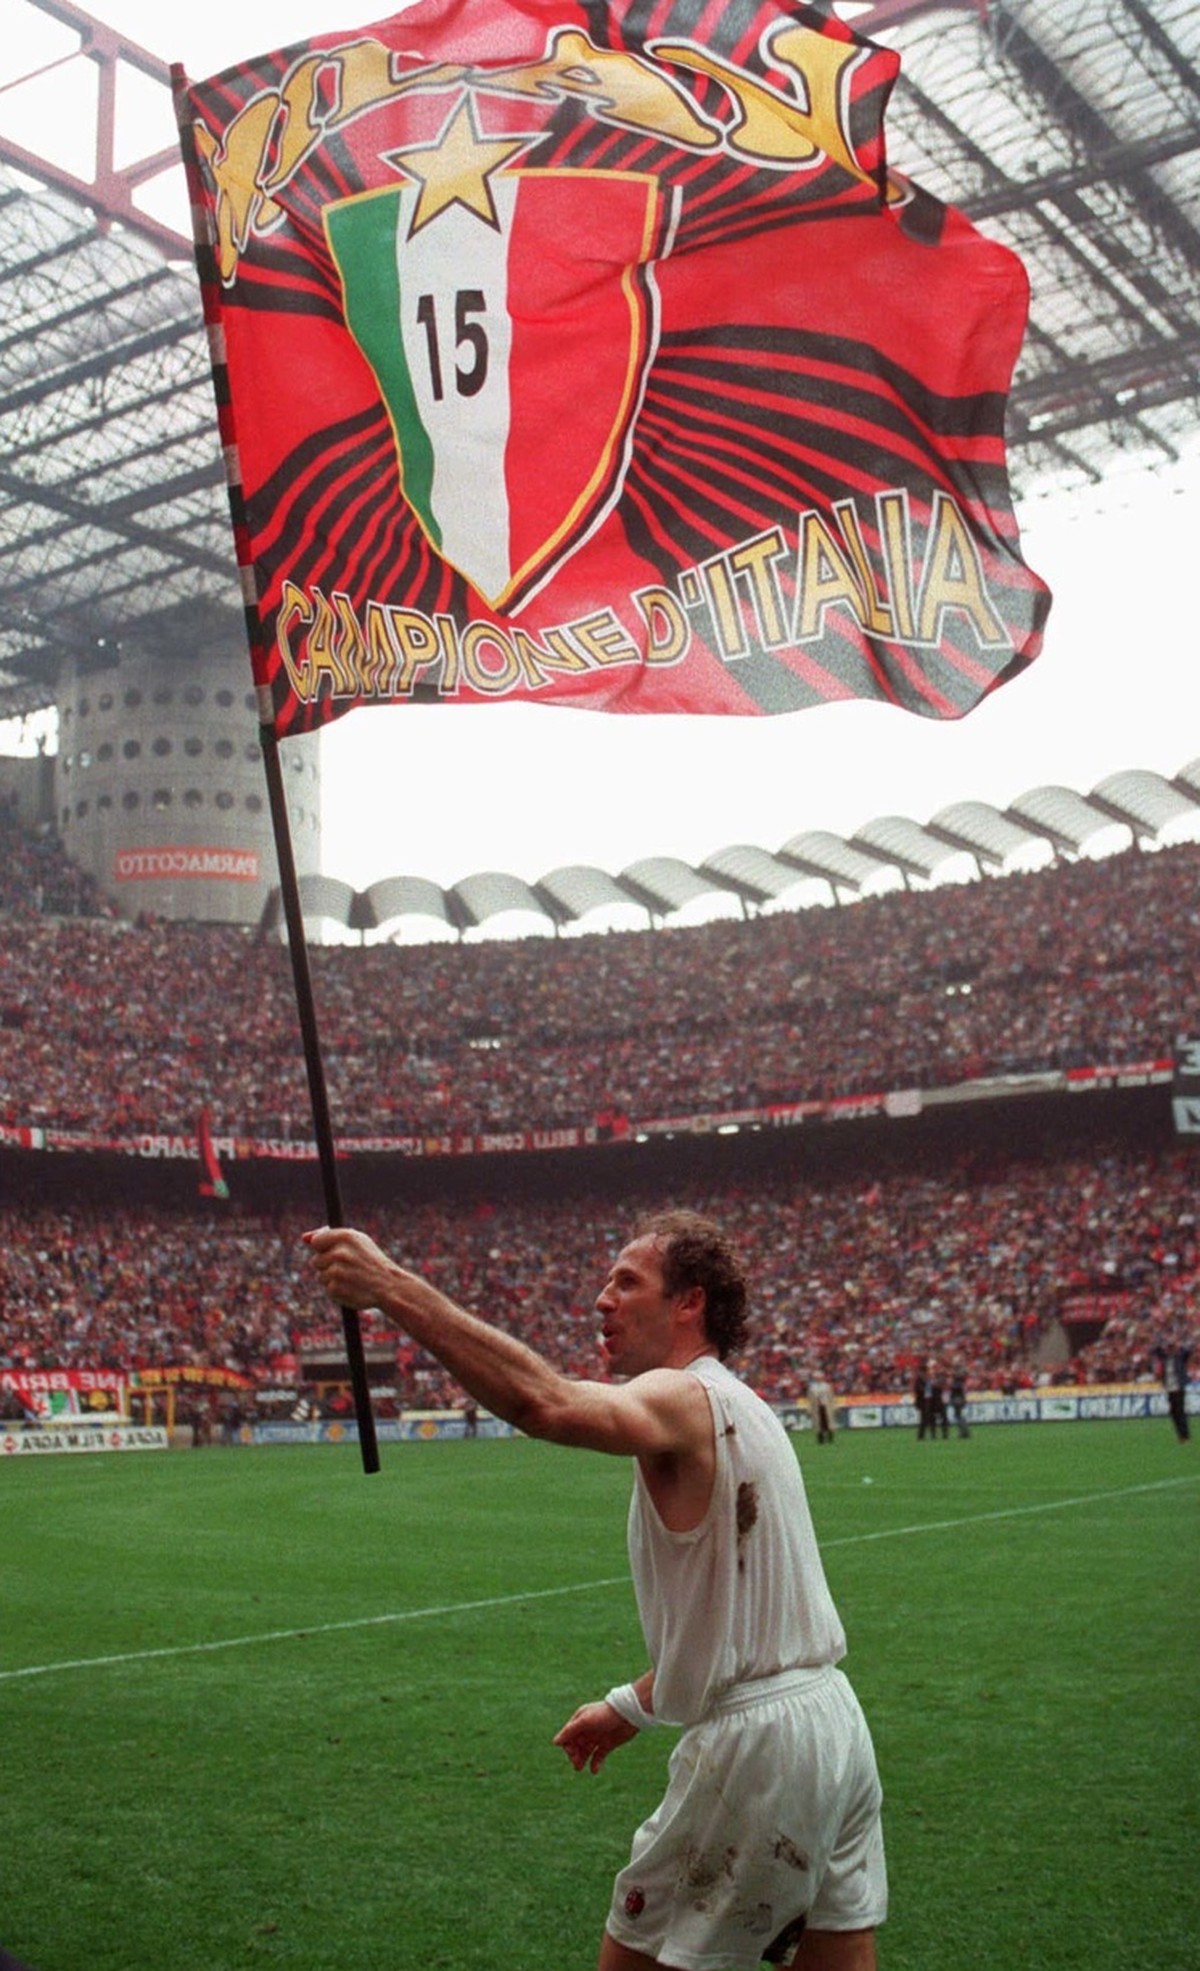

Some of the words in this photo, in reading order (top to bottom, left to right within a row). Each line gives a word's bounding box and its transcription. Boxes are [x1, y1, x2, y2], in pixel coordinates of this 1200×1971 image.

[416, 289, 489, 402] 15
[279, 580, 640, 703] CAMPIONE
[631, 487, 1012, 665] D'ITALIA
